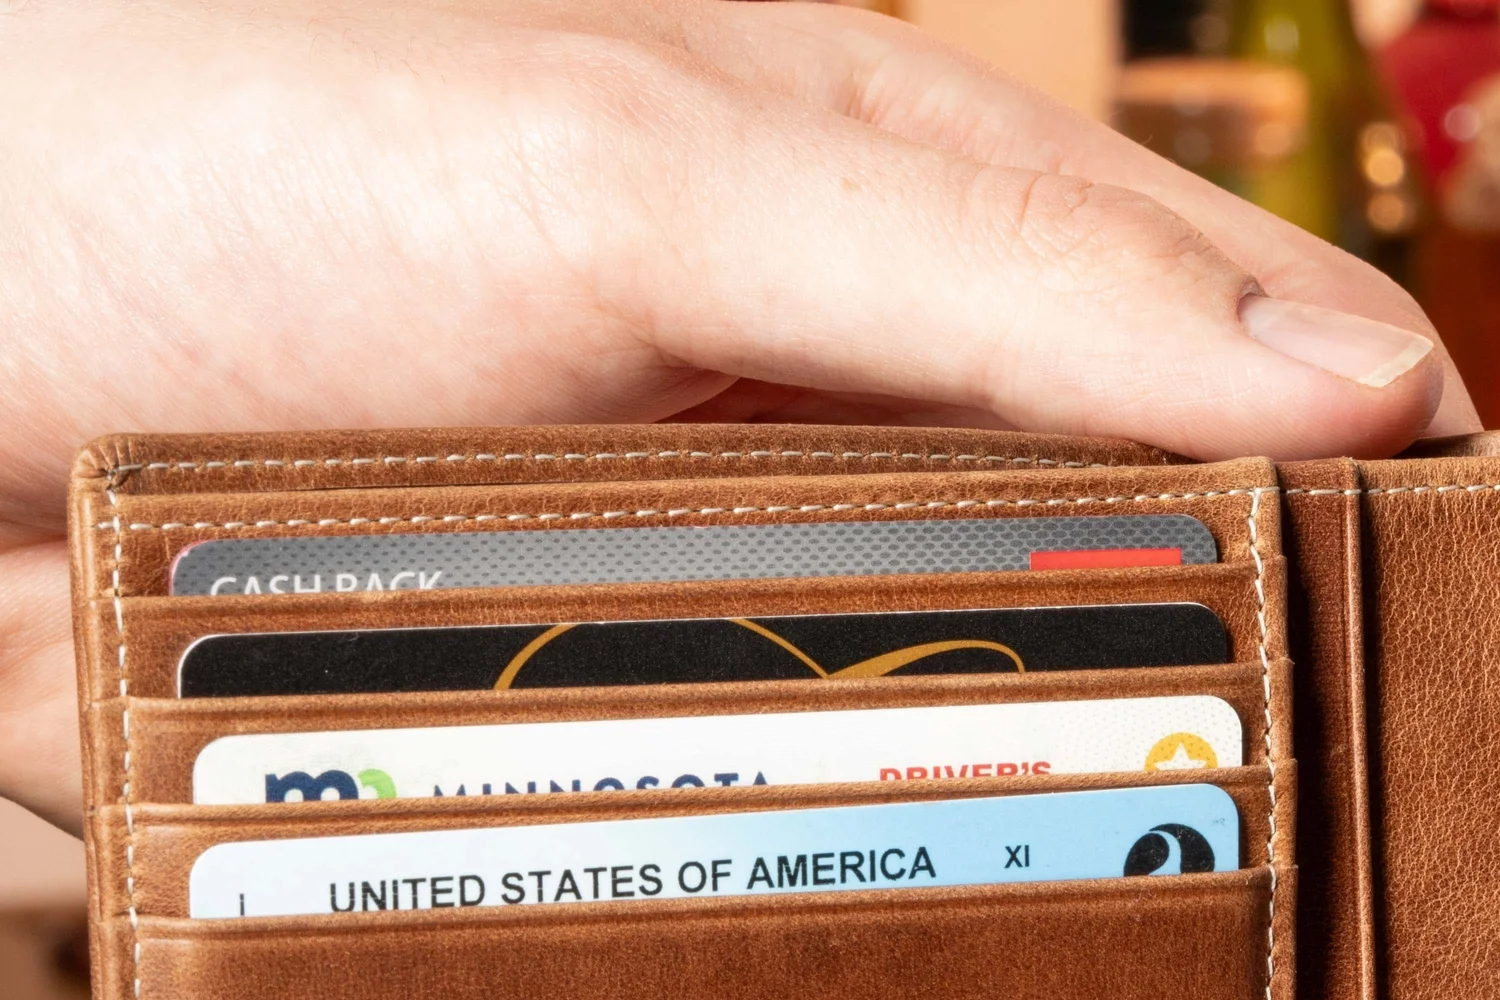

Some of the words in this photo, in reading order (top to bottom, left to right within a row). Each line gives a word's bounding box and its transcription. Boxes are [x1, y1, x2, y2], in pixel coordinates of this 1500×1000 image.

[329, 874, 486, 913] UNITED
[500, 863, 664, 905] STATES
[677, 858, 733, 893] OF
[746, 845, 937, 890] AMERICA
